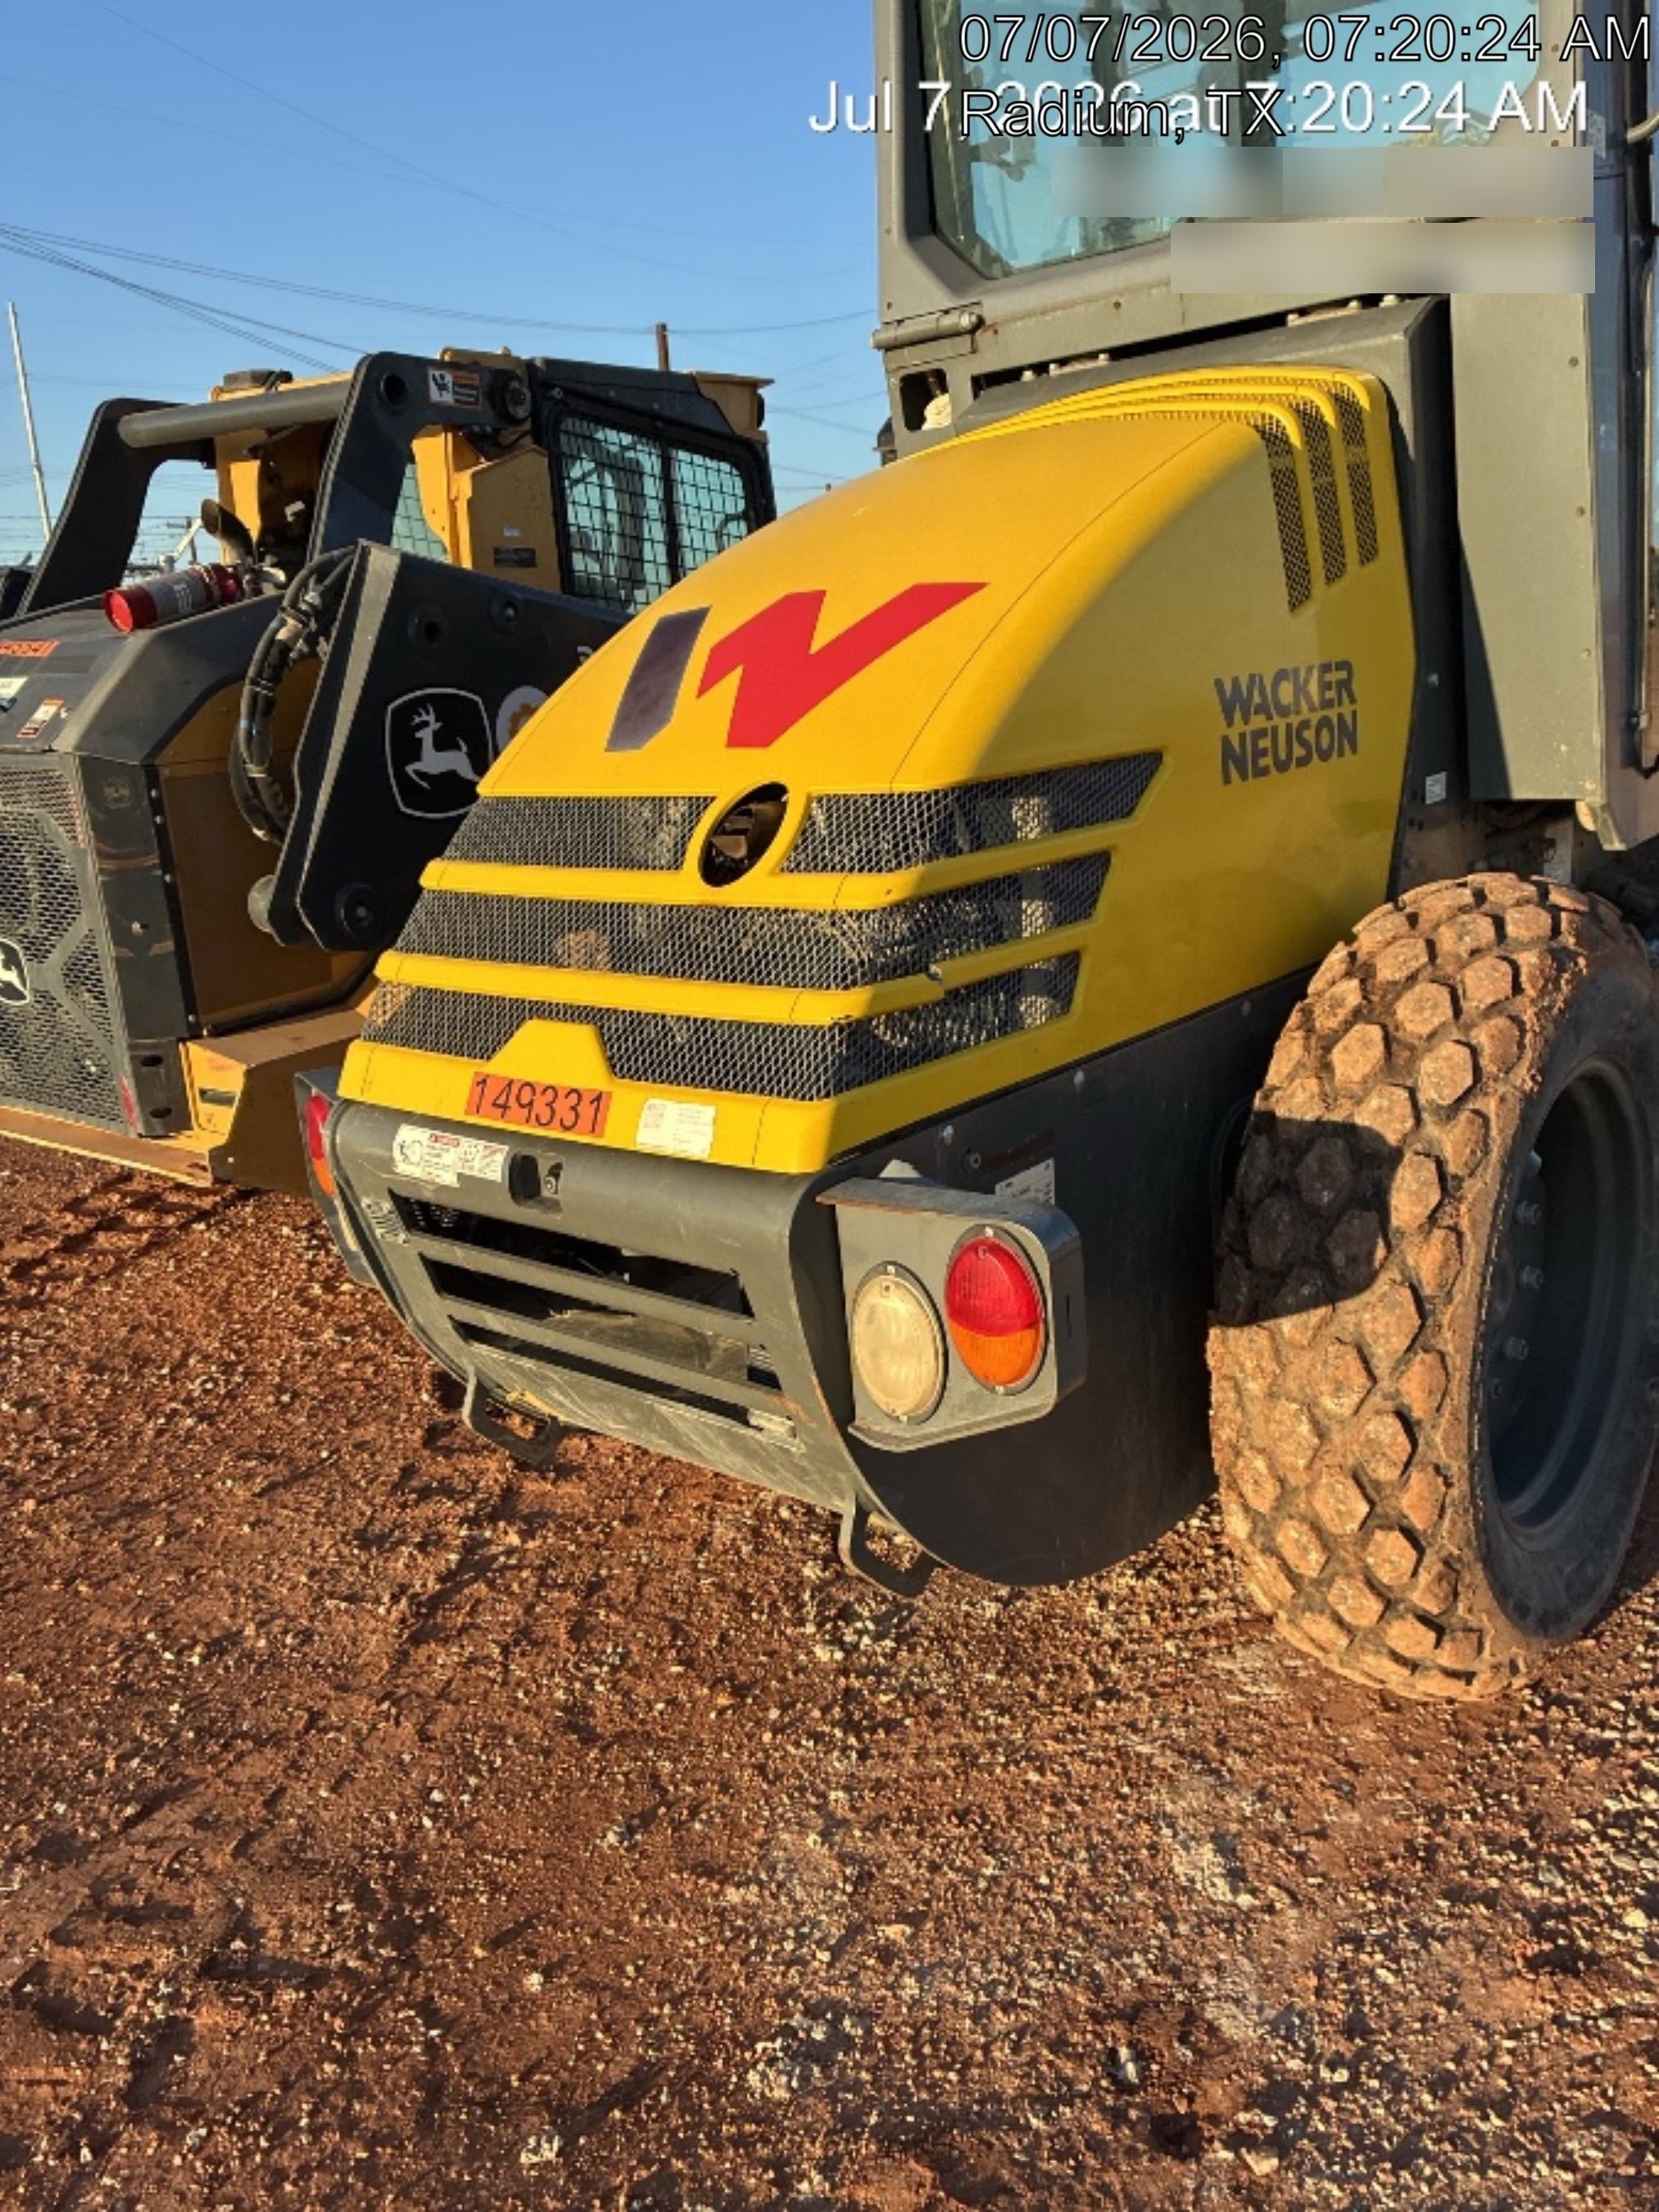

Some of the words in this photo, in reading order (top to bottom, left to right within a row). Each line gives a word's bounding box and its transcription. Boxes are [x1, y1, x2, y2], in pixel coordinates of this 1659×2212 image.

[1213, 660, 1358, 728] WACKER
[1221, 709, 1358, 786] NEUSON
[475, 1072, 605, 1135] 149331
